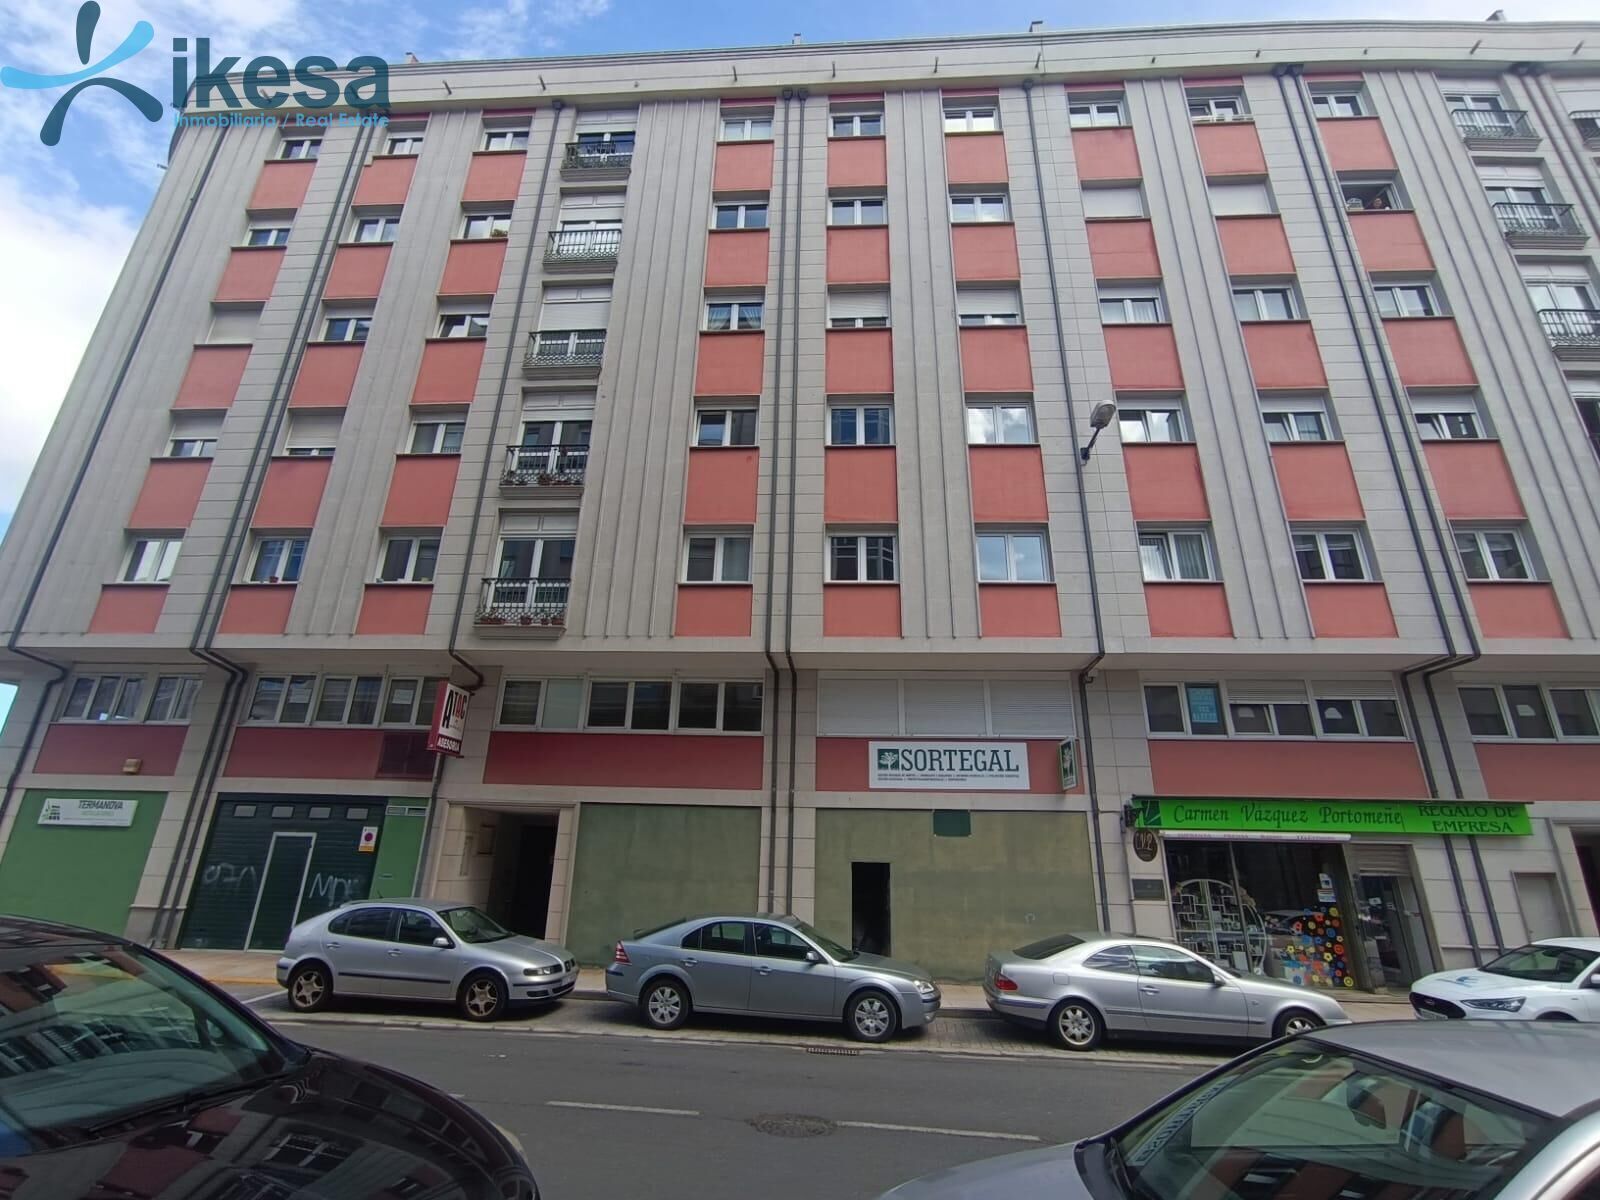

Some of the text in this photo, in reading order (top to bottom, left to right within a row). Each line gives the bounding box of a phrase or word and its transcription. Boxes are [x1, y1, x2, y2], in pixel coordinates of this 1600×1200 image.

[901, 748, 1020, 772] SORTEGAL
[78, 800, 124, 810] TERMANOVA
[1417, 805, 1519, 818] REGALO DE
[1173, 804, 1229, 824] Carmen
[1241, 801, 1309, 829] Vázquez
[1432, 820, 1514, 833] EMPRESA
